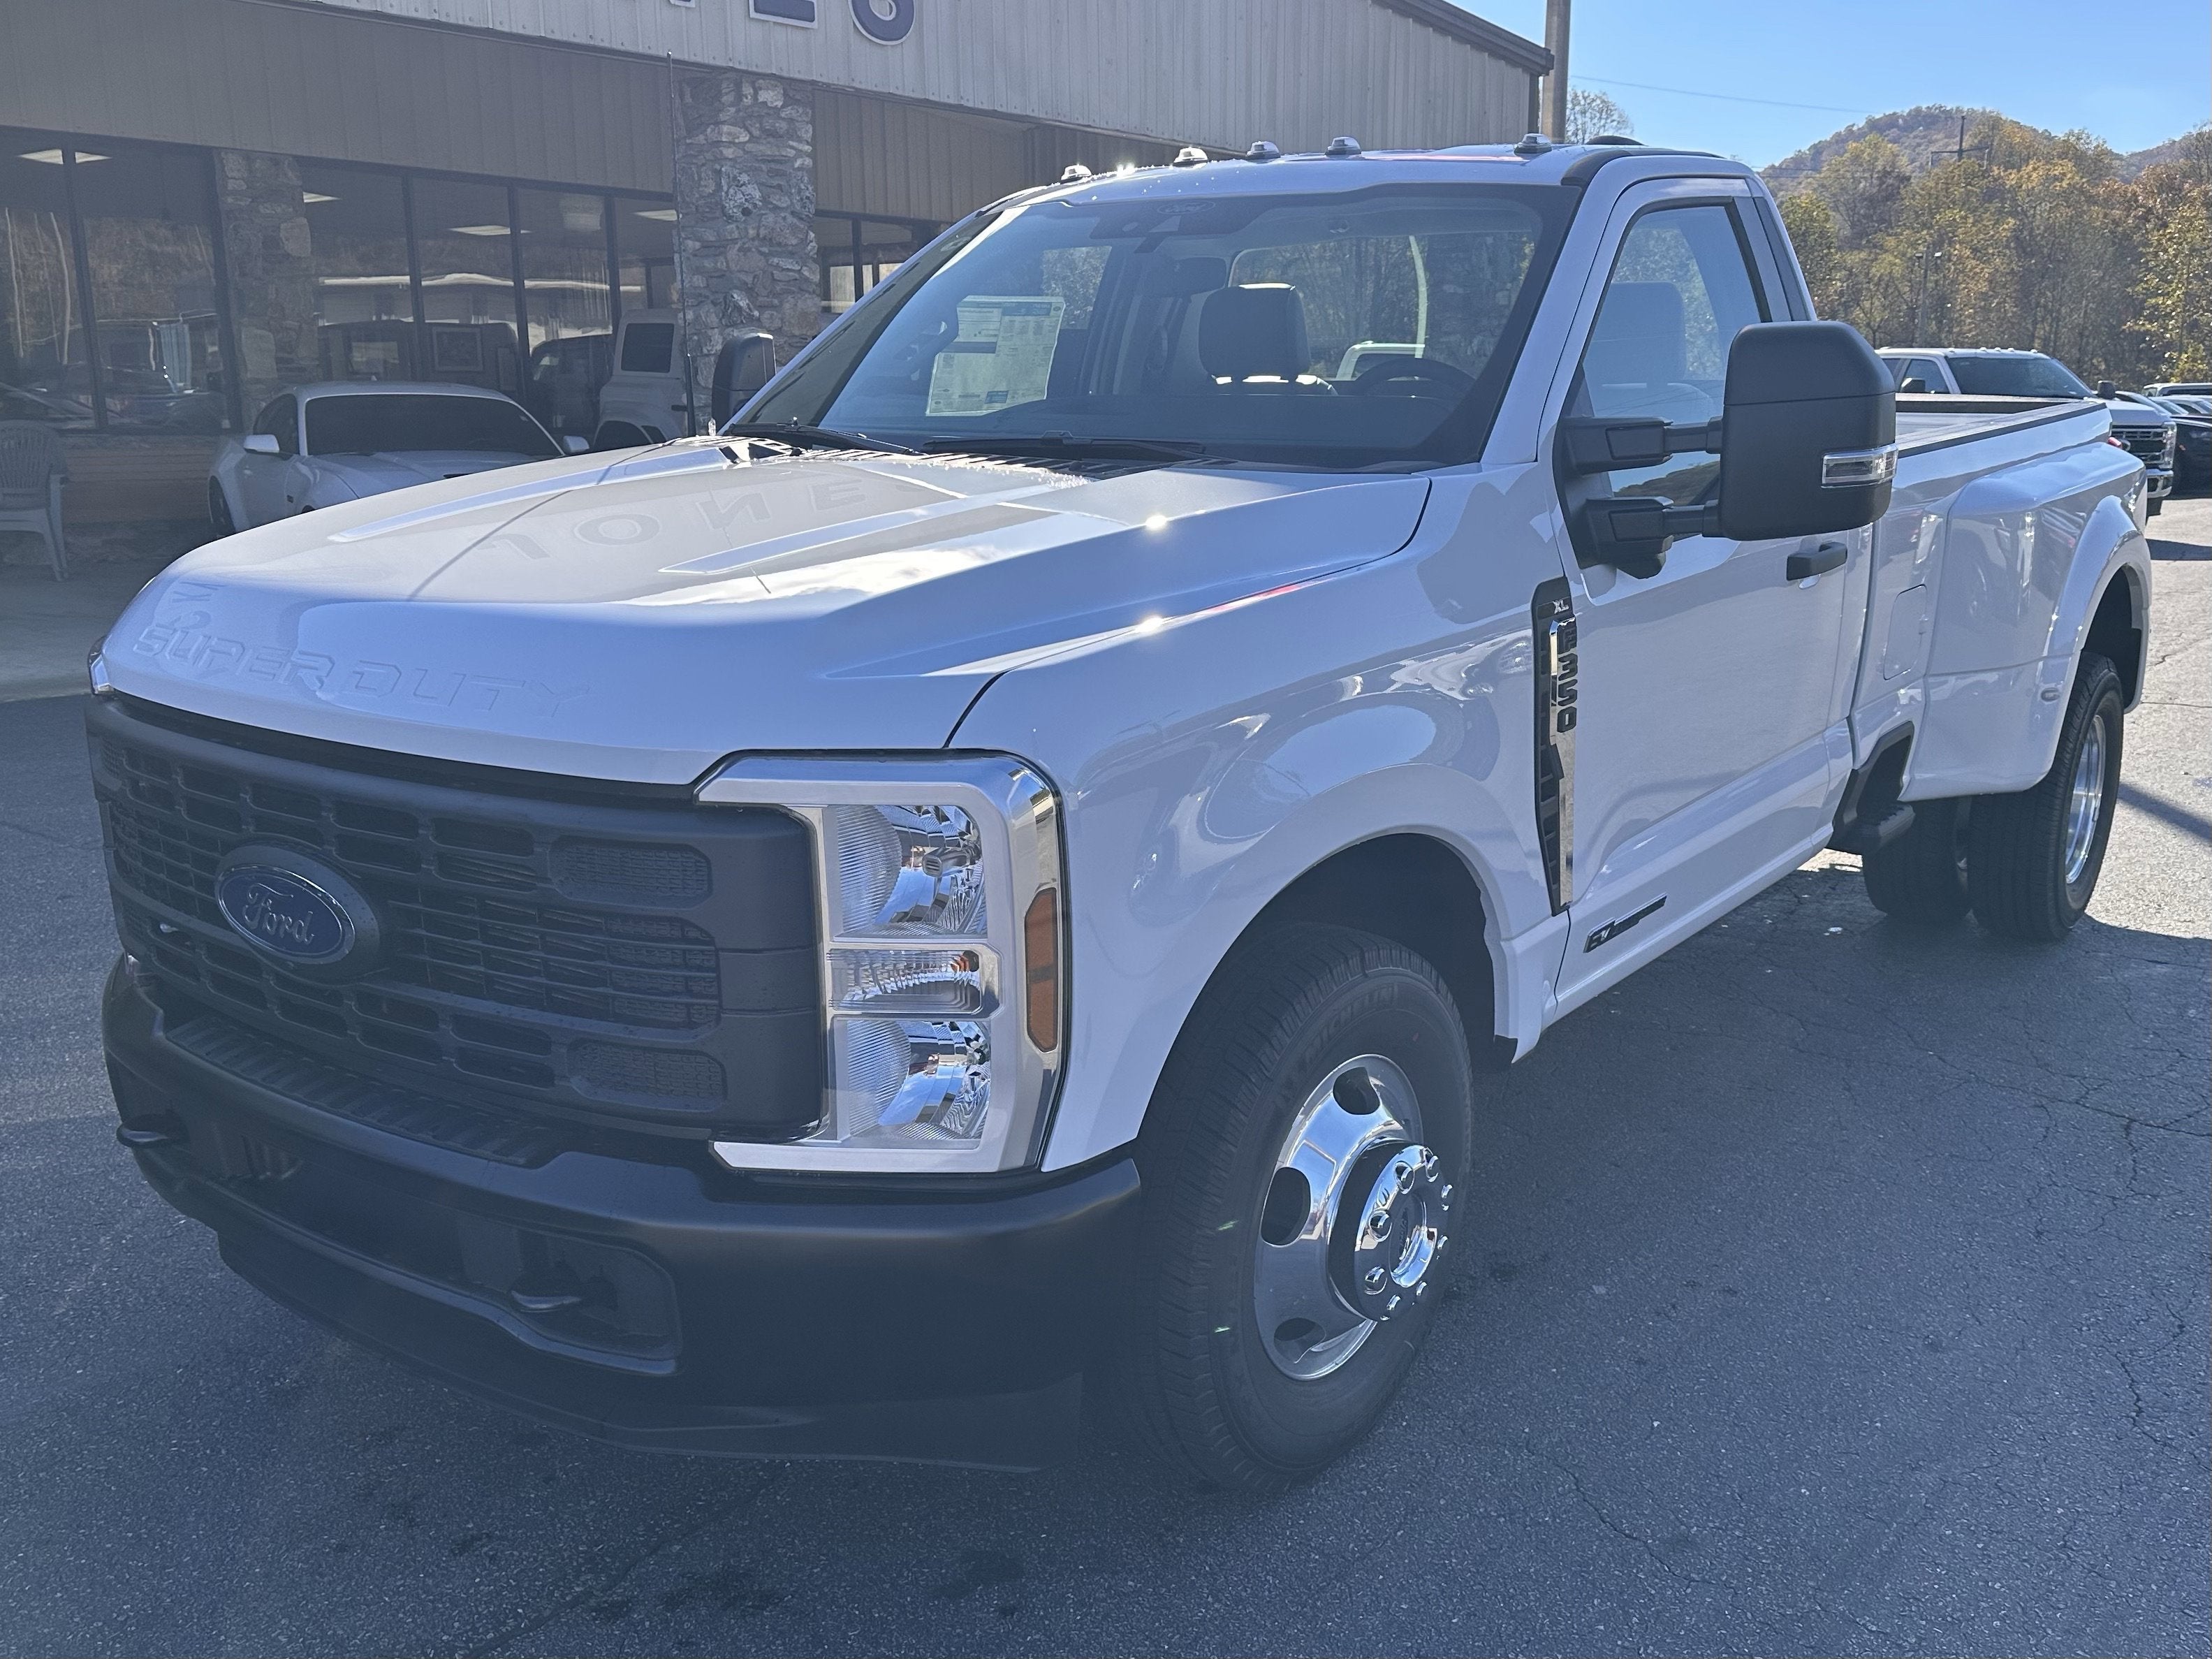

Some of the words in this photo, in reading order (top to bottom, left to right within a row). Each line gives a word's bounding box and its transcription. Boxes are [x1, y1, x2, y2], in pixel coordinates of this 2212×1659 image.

[1553, 599, 1569, 615] XL
[132, 624, 336, 692] SUPER
[352, 659, 591, 718] DUTY
[242, 882, 316, 945] Ford
